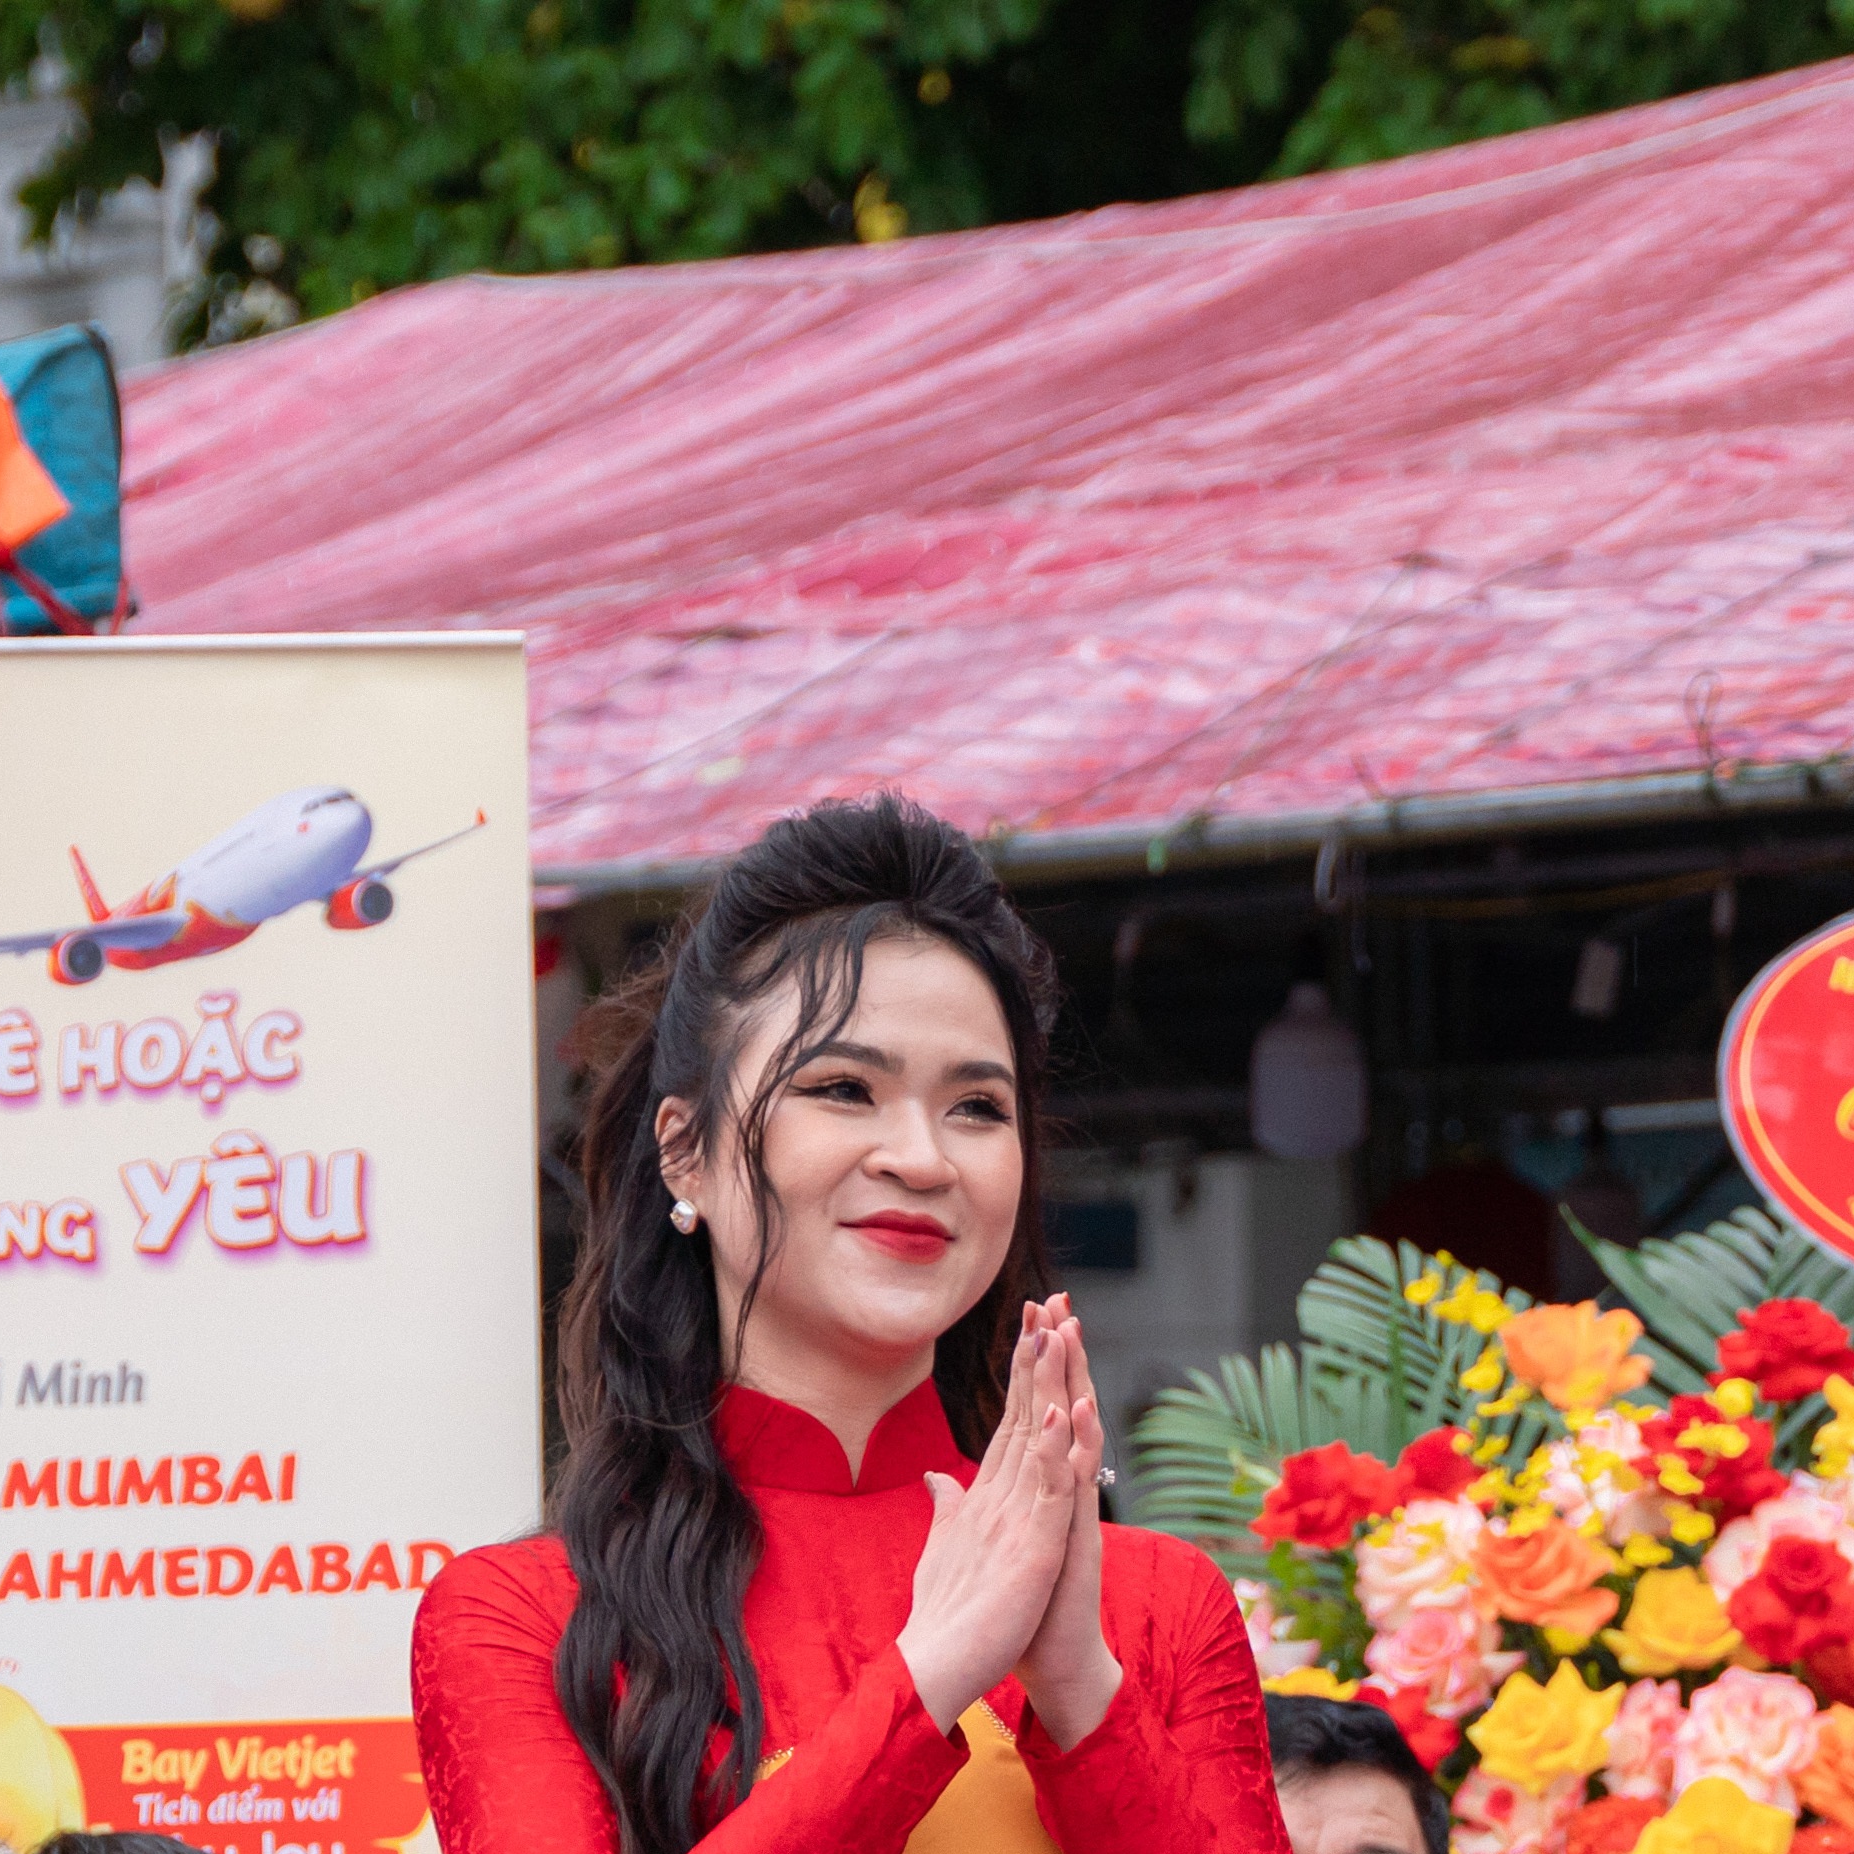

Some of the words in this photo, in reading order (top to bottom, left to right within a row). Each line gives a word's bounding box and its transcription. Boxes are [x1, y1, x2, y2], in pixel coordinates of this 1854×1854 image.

[58, 992, 303, 1105] HOẶC
[118, 1129, 368, 1254] YÊU
[16, 1360, 146, 1408] Minh
[0, 1451, 298, 1509] MUMBAI
[121, 1739, 205, 1791] Bay
[215, 1735, 356, 1788] Vietjet
